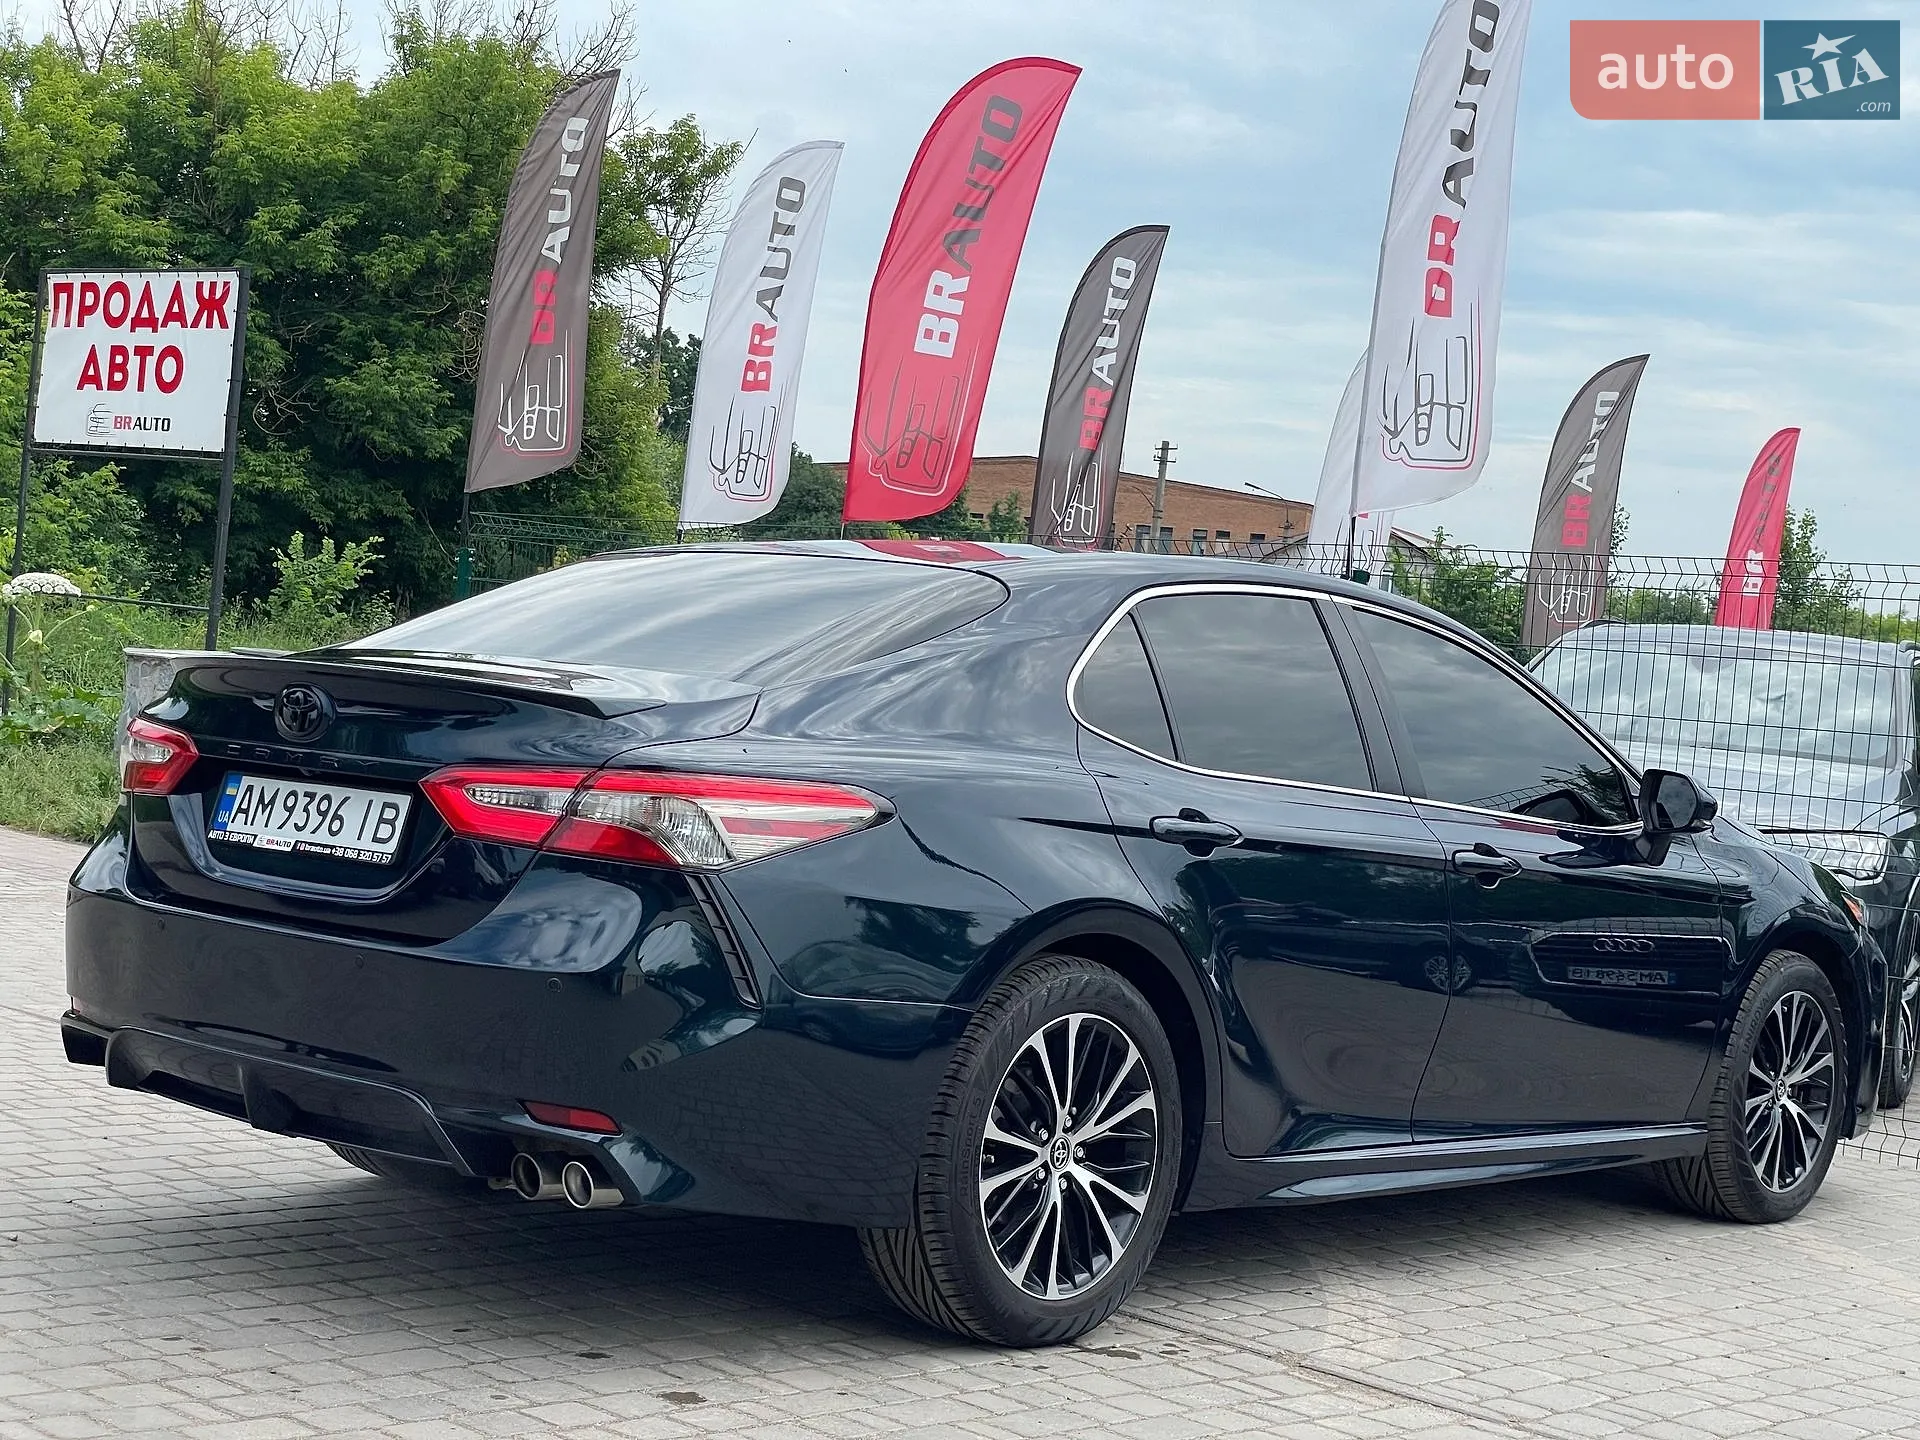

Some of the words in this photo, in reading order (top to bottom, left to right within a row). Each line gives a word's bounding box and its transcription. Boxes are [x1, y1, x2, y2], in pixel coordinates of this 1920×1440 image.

[913, 94, 1024, 359] BRAUTO
[51, 280, 231, 333] ПРОДАЖ
[740, 176, 806, 393] BRAUTO
[76, 344, 185, 394] АВТО
[1079, 256, 1137, 451] BRAUTO
[113, 416, 171, 432] BRAUTO
[1561, 391, 1620, 547] BRAUTO
[217, 810, 229, 823] UA
[277, 789, 351, 837] 9396
